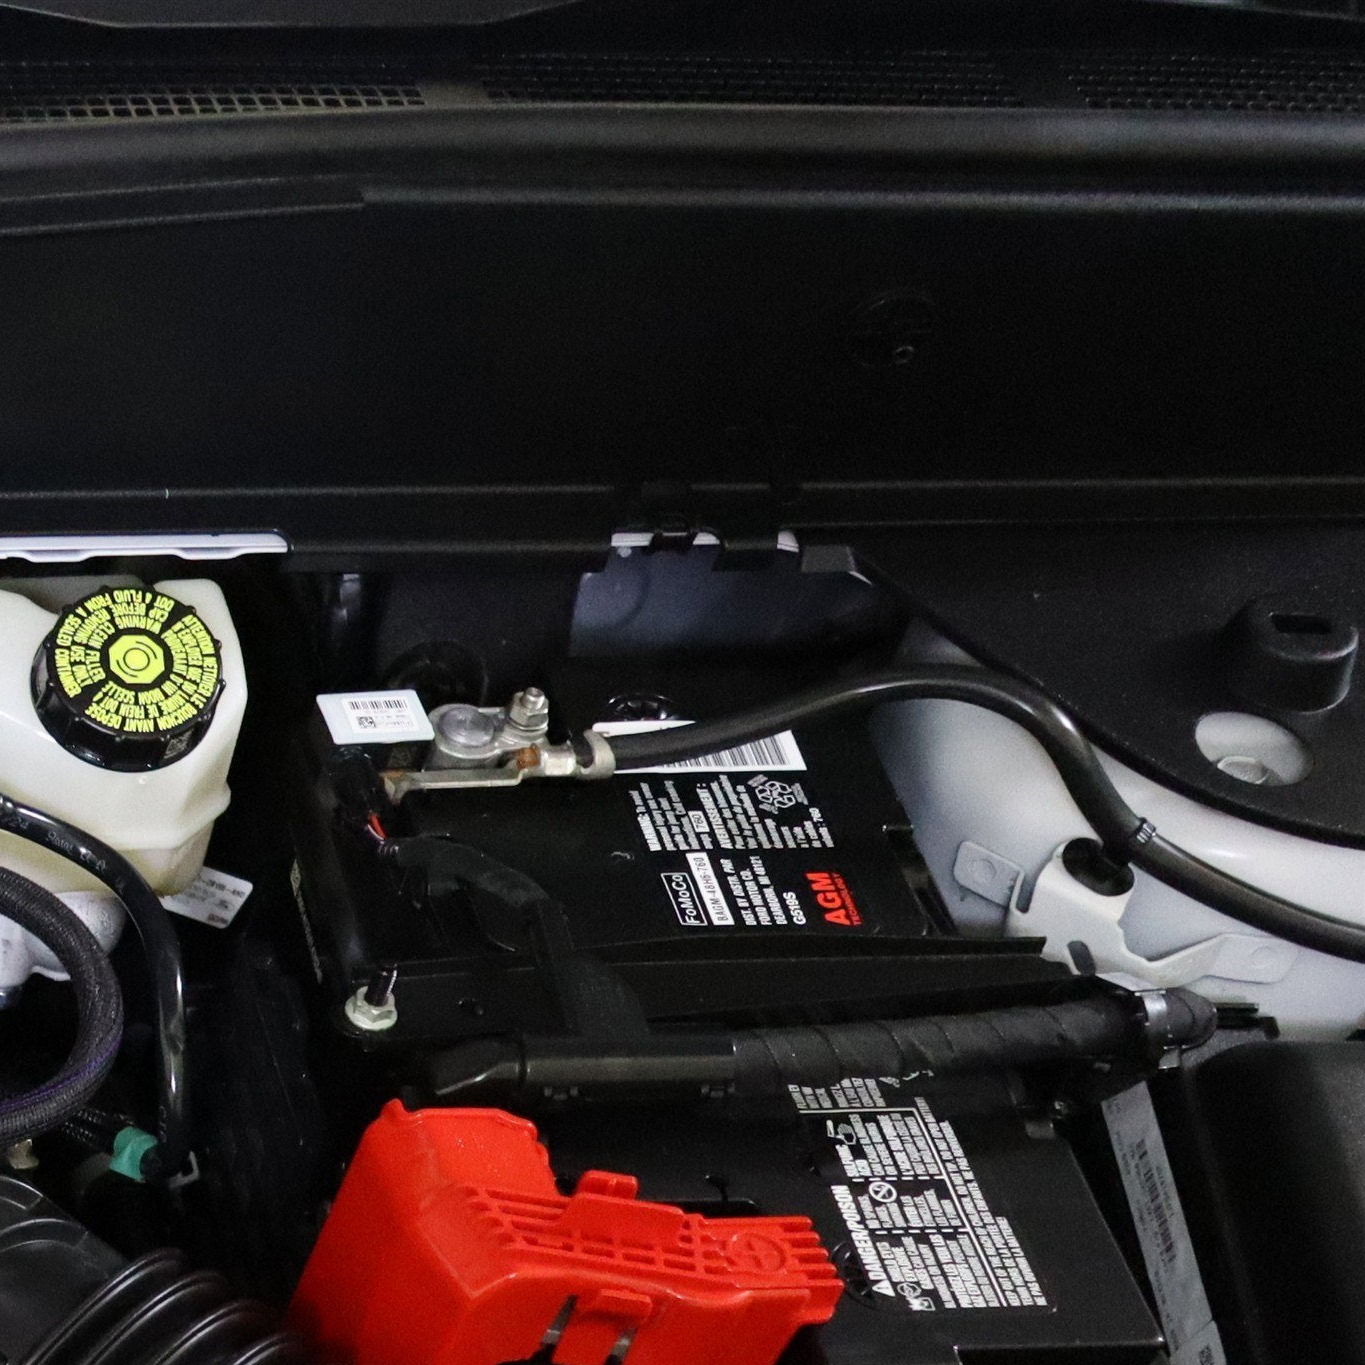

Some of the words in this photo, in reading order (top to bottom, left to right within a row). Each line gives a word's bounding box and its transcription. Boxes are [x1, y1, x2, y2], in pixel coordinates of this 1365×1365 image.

[113, 590, 142, 603] FLUID
[692, 814, 705, 829] 760
[672, 875, 700, 923] FoMoCo
[745, 881, 764, 905] MOTOR
[805, 873, 851, 925] AGM
[755, 907, 772, 925] FORD
[783, 892, 806, 924] G519S
[831, 1185, 887, 1280] DANGER/POISON
